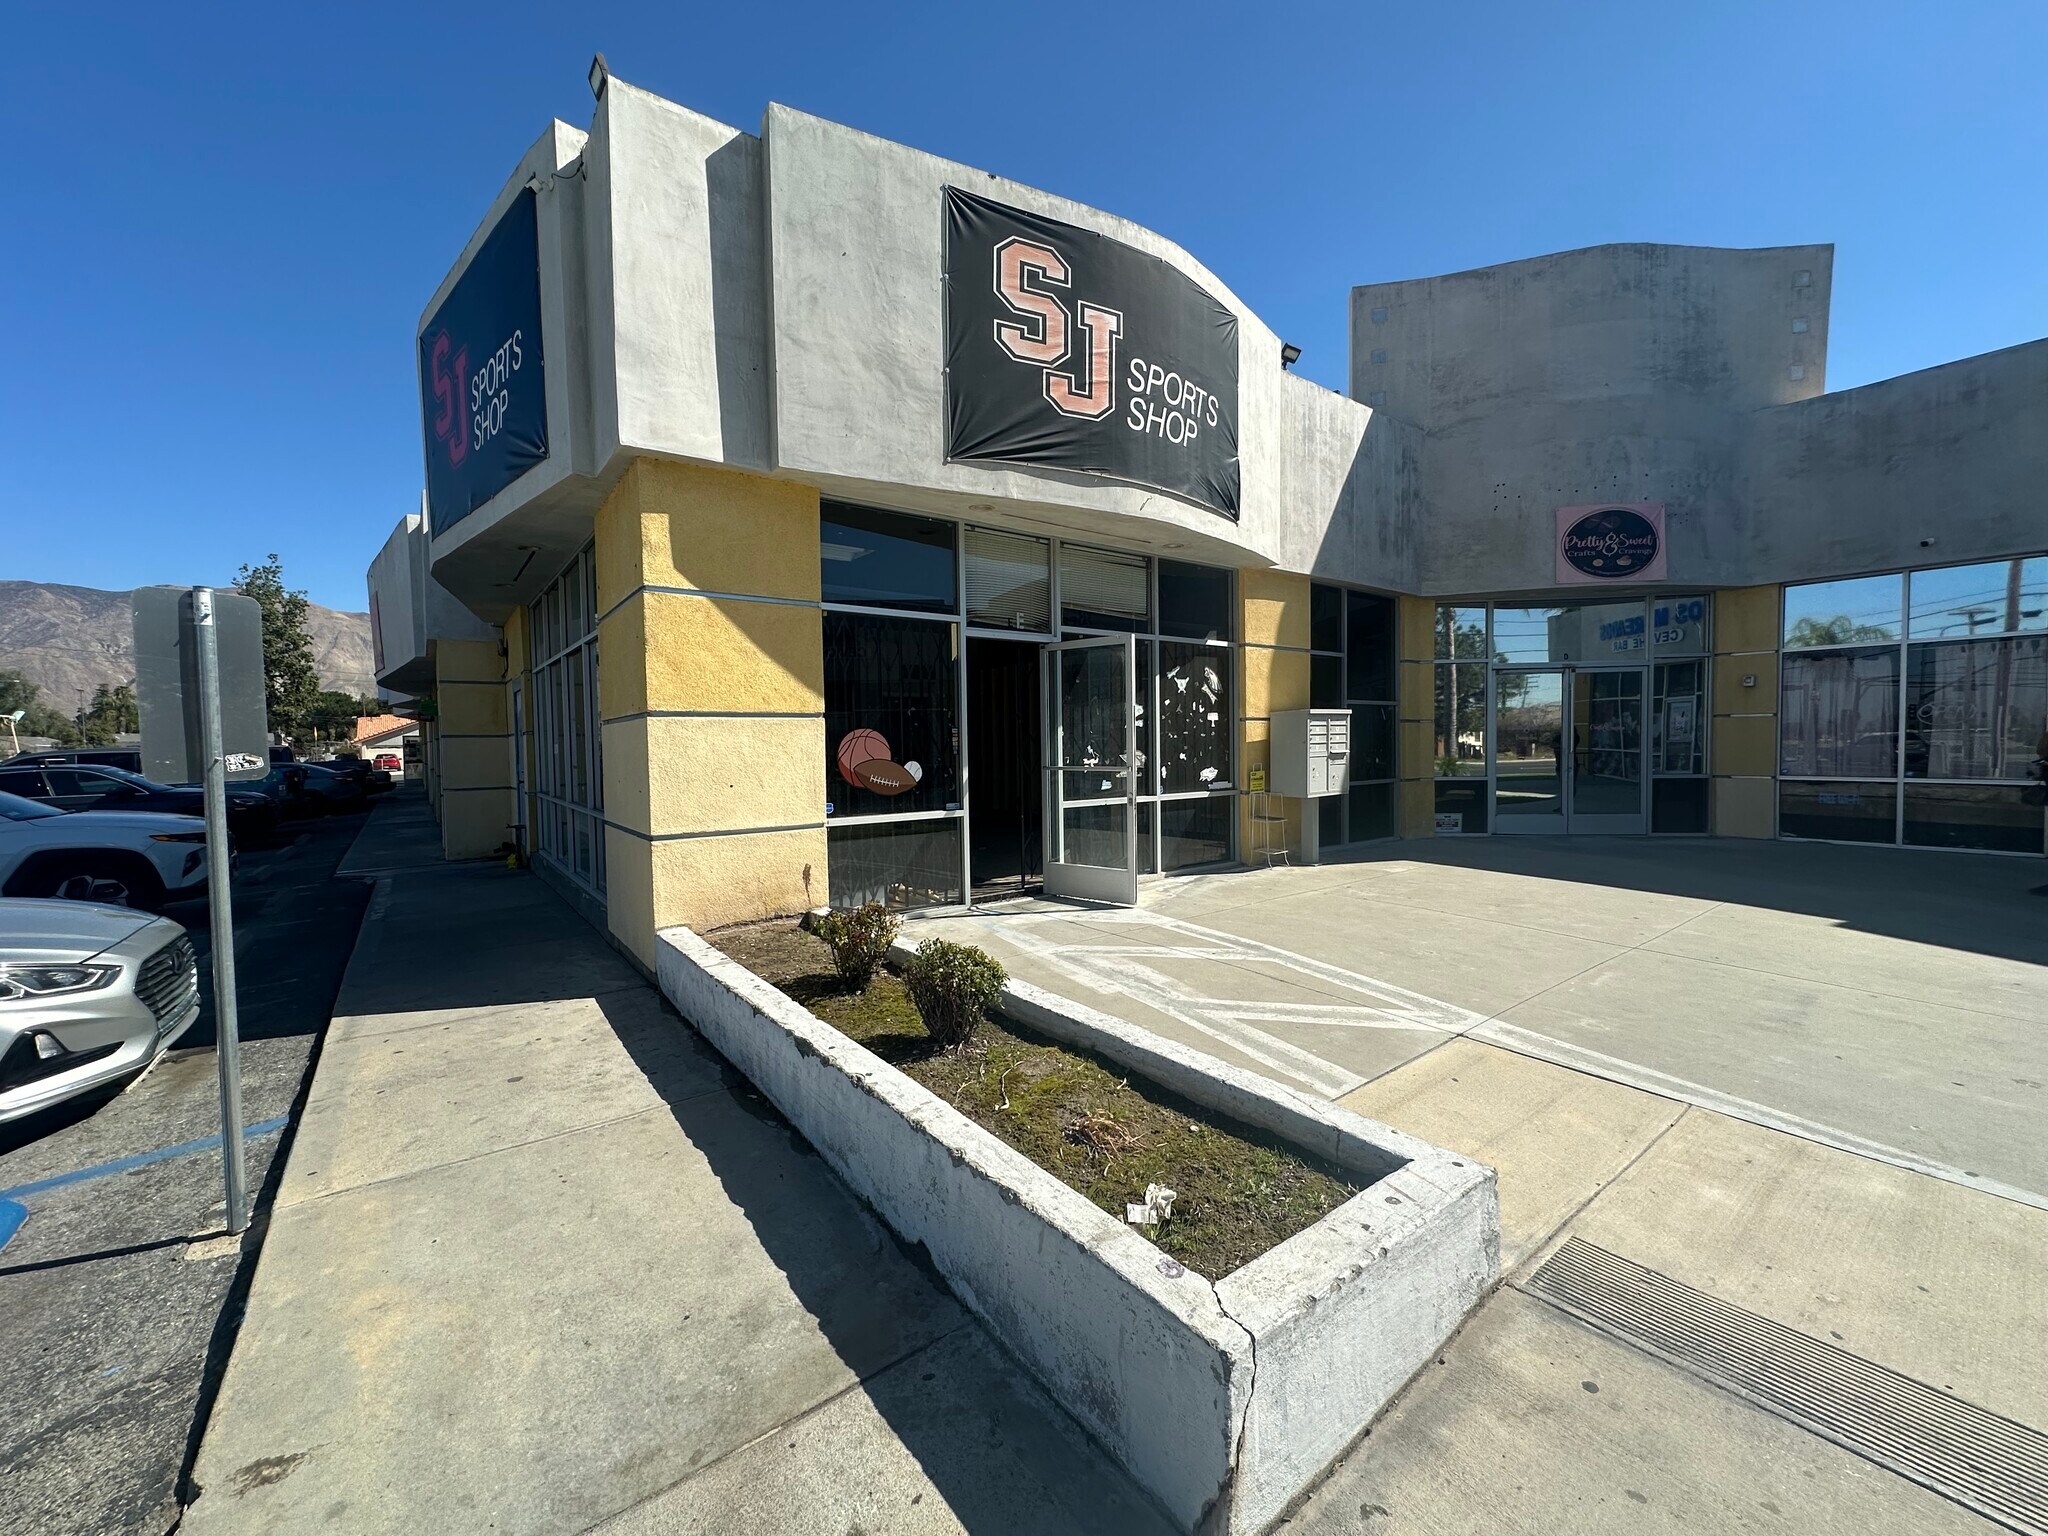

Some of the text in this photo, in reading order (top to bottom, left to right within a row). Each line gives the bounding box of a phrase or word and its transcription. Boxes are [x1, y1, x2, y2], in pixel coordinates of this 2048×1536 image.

[992, 235, 1124, 422] SJ
[430, 328, 469, 471] SJ
[470, 329, 522, 413] SPORTS
[1127, 358, 1219, 427] SPORTS
[473, 389, 509, 452] SHOP
[1127, 396, 1198, 447] SHOP
[1564, 535, 1605, 551] Pretty
[1617, 533, 1653, 547] Sweet
[1567, 549, 1596, 557] Crafts
[1016, 612, 1025, 629] E
